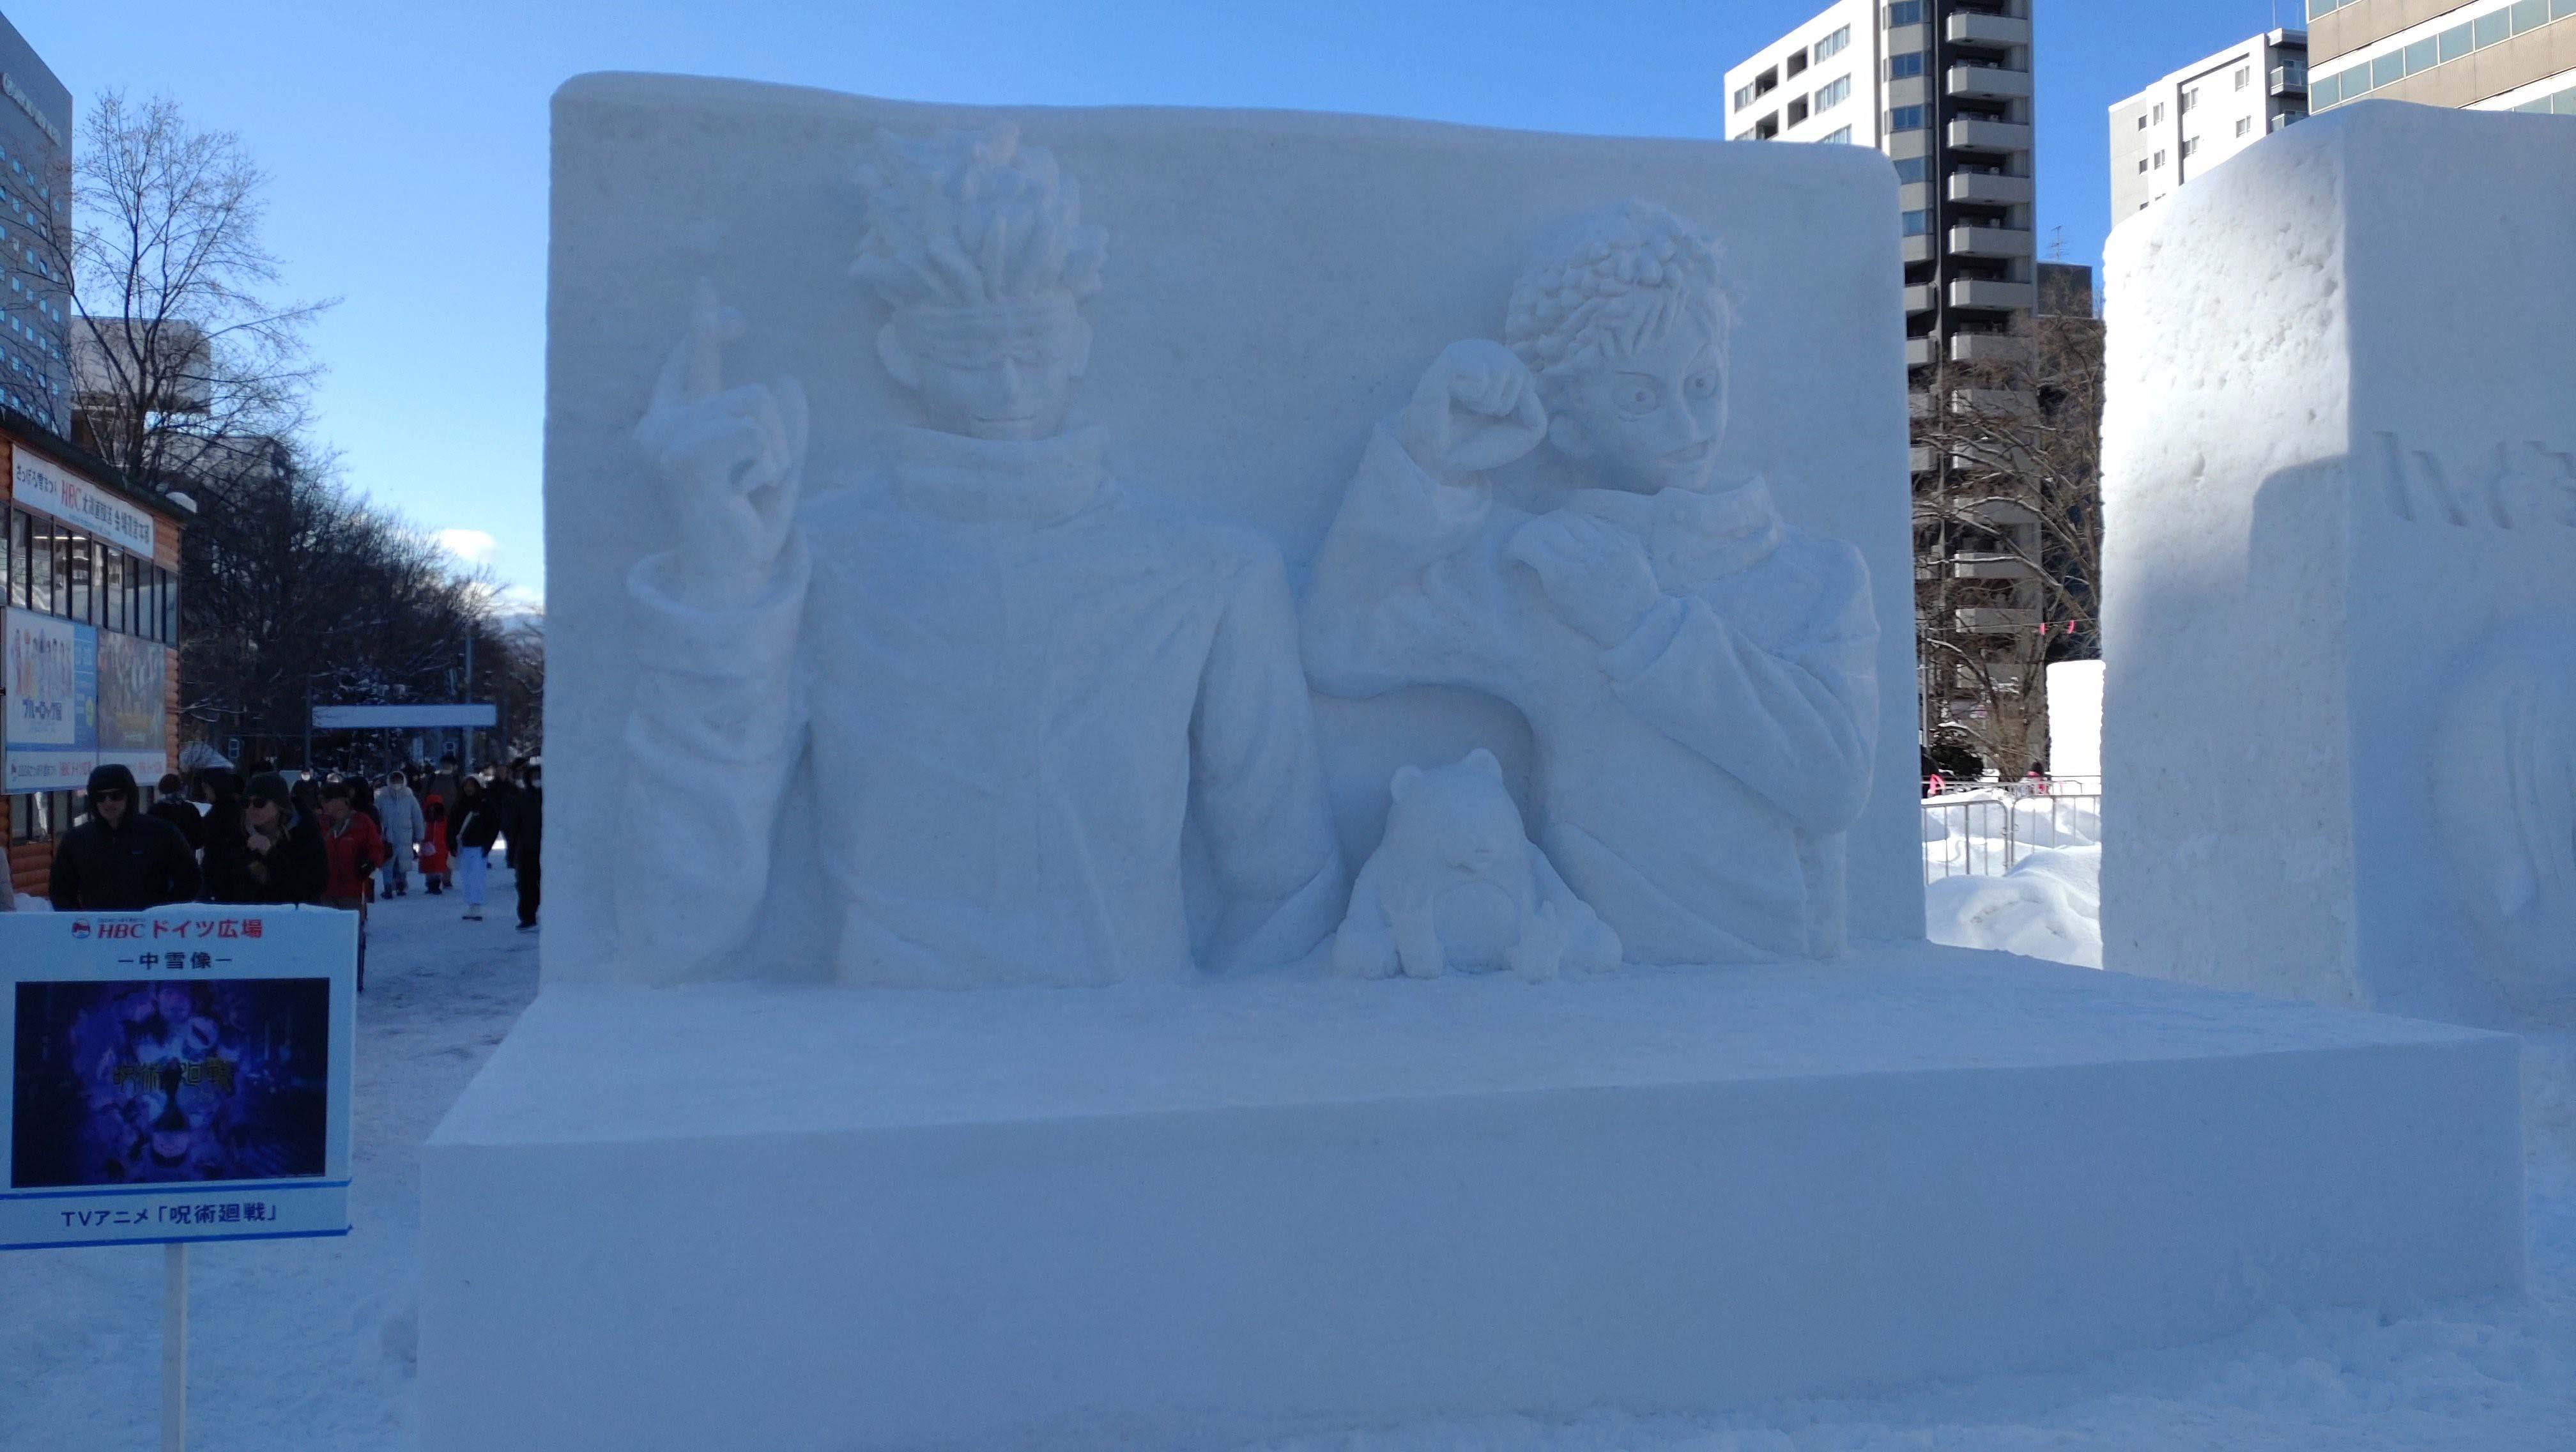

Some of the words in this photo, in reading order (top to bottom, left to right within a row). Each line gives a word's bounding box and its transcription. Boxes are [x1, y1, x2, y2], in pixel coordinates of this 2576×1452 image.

[98, 923, 144, 939] HBC
[152, 919, 262, 939] ドイツ広場
[61, 1202, 277, 1226] TVアニメ「呪術廻戦」
